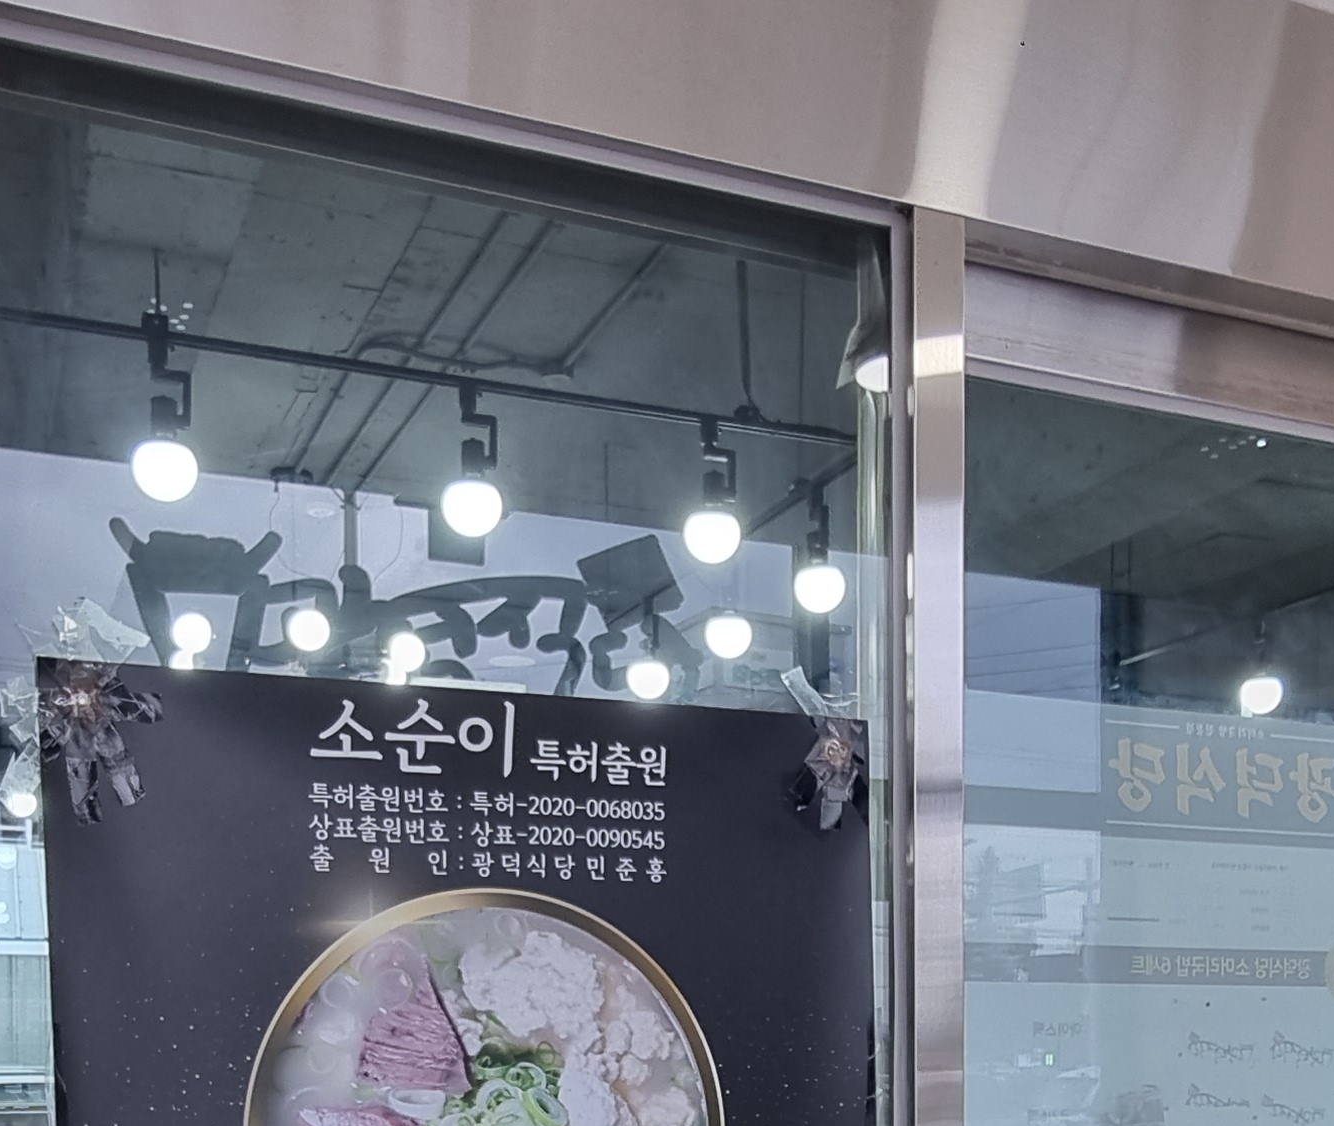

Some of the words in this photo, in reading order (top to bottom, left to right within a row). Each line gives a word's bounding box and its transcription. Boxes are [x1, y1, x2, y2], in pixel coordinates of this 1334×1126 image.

[309, 698, 516, 779] 소순이
[530, 739, 667, 787] 특허출원
[307, 782, 449, 813] 특허출원번호
[470, 791, 666, 821] 특허-2020-0068035
[308, 814, 450, 845] 상표출원번호
[471, 821, 666, 851] 상표-2020-0090545
